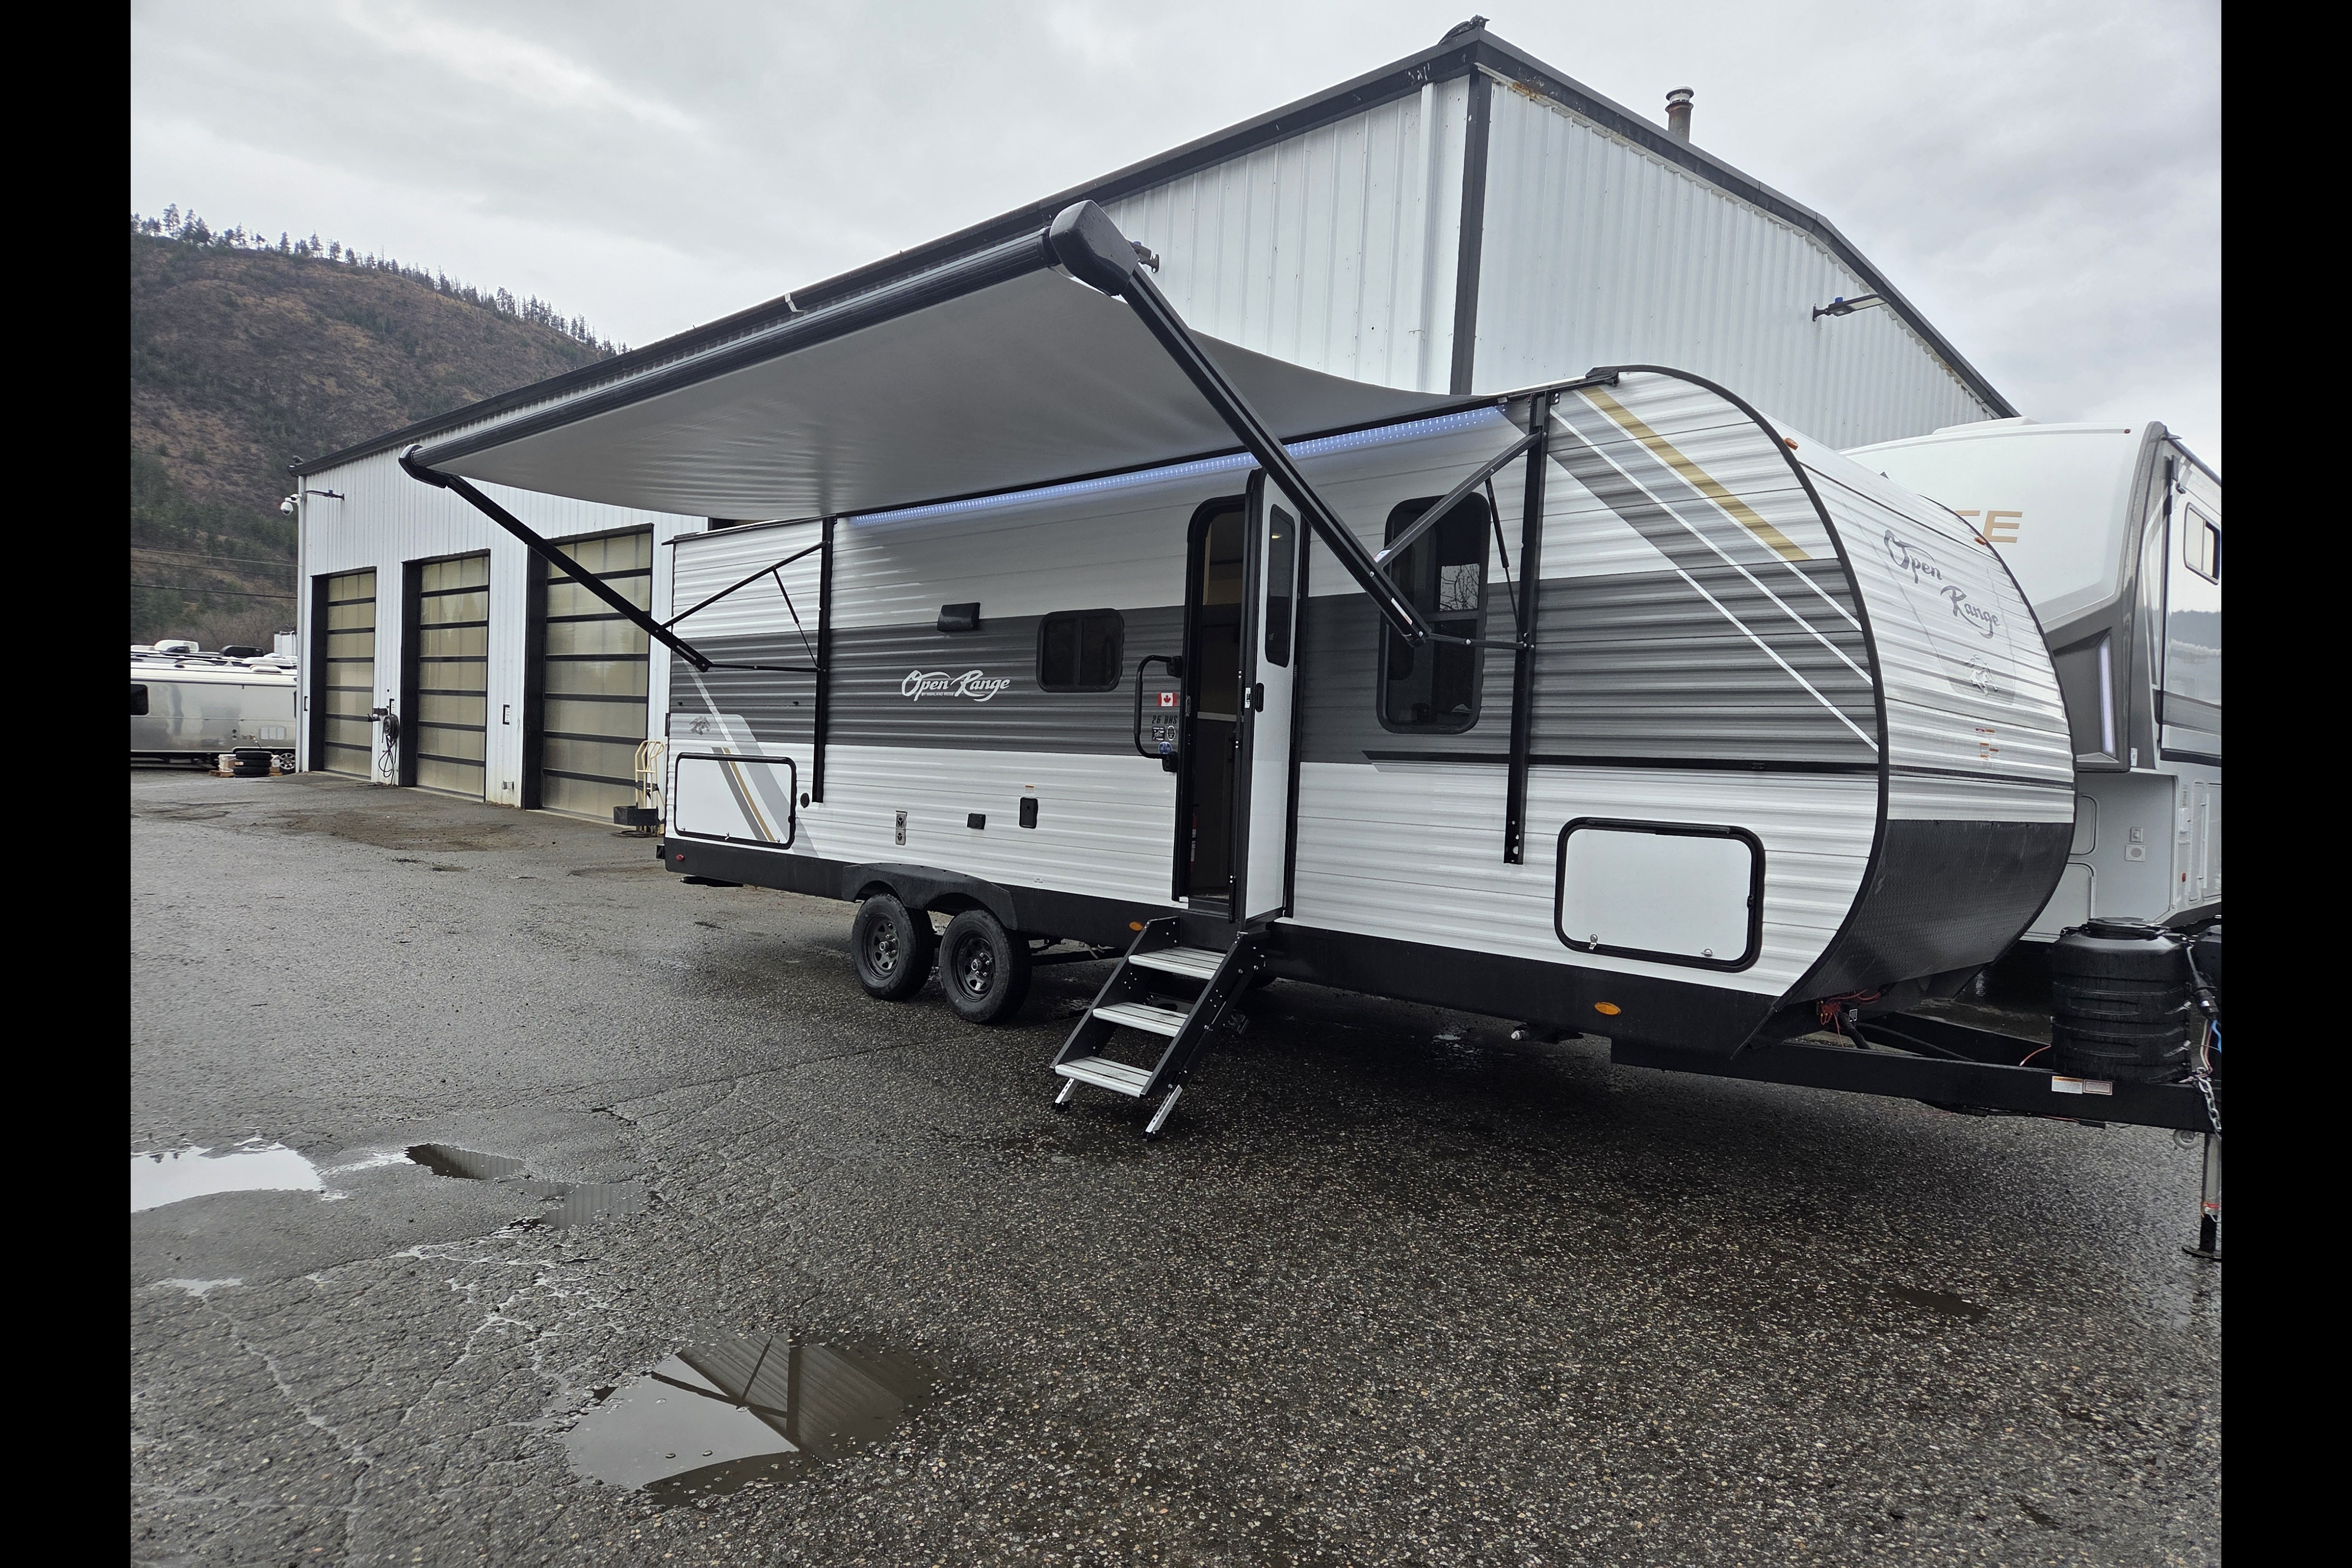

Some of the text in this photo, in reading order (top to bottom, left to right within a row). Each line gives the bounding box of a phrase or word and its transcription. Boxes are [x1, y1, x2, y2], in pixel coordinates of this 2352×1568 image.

[1884, 529, 2001, 639] Open Range
[901, 670, 1010, 702] Open Range
[1151, 714, 1178, 724] 26 BHS
